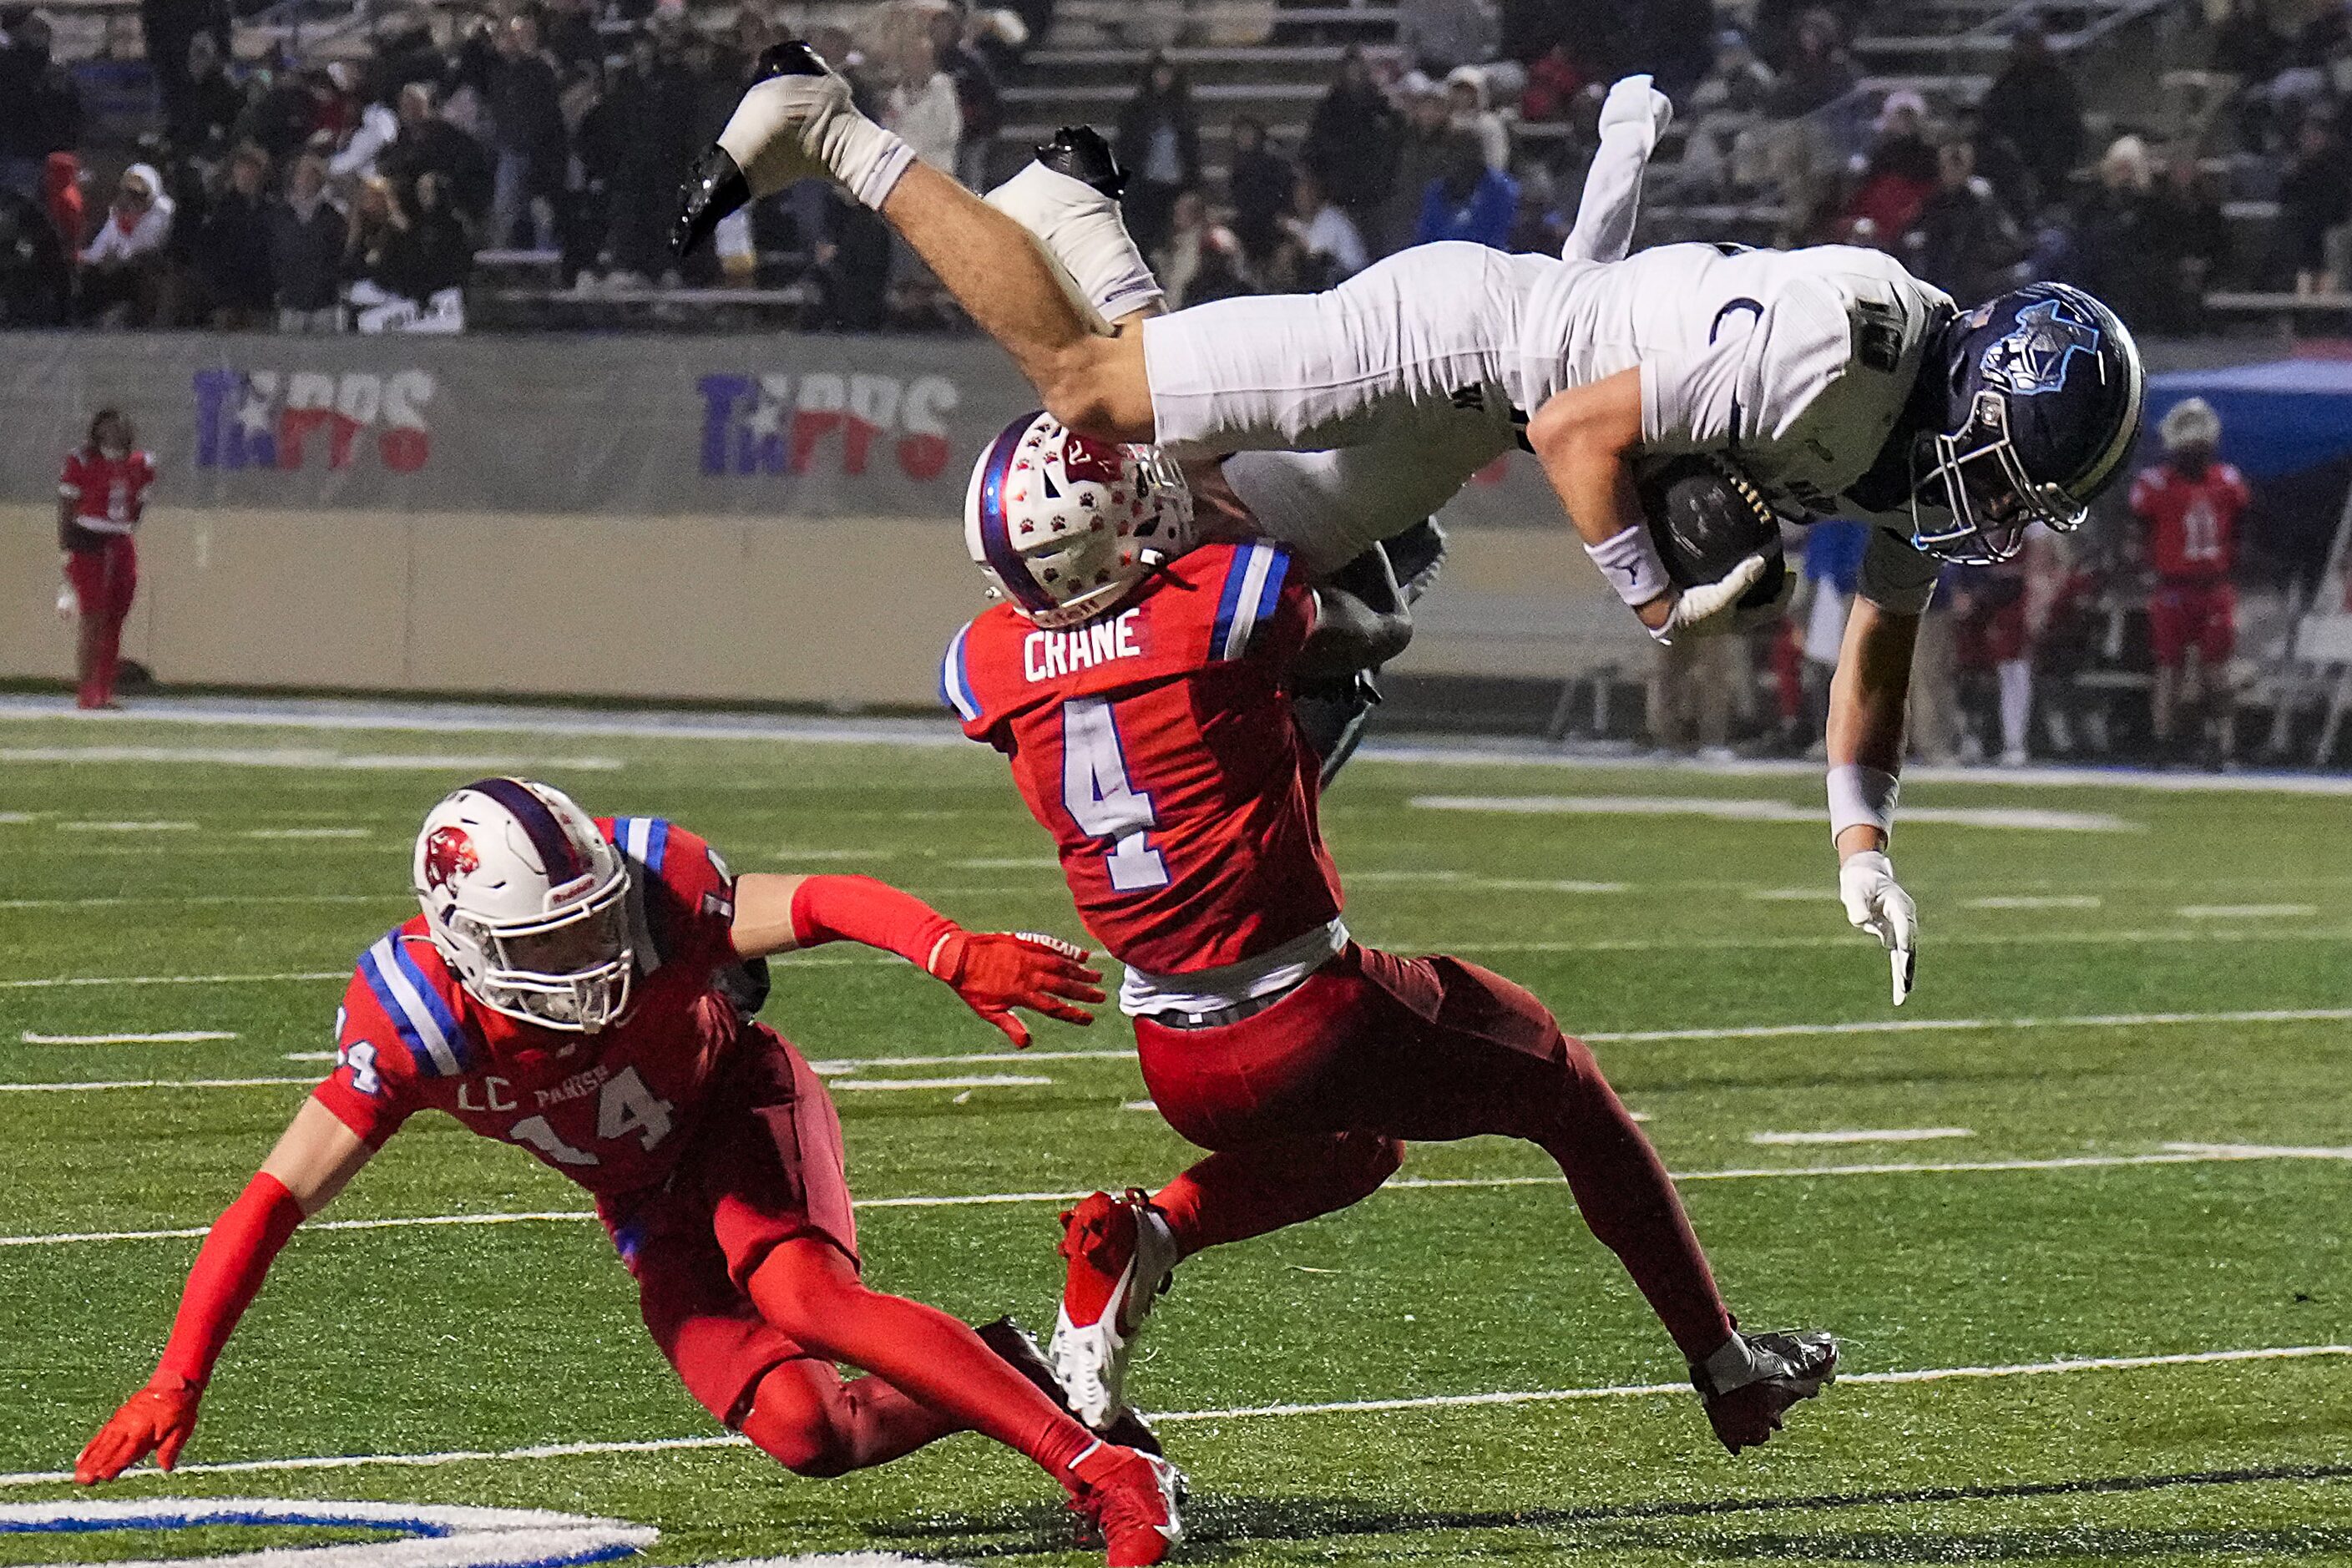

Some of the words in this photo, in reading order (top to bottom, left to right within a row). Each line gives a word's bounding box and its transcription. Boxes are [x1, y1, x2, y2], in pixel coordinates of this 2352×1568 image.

[1024, 607, 1141, 682] CRANE
[1062, 695, 1171, 892] 4
[458, 1076, 518, 1112] LC
[509, 1065, 673, 1166] 14
[534, 1065, 609, 1108] PARISH
